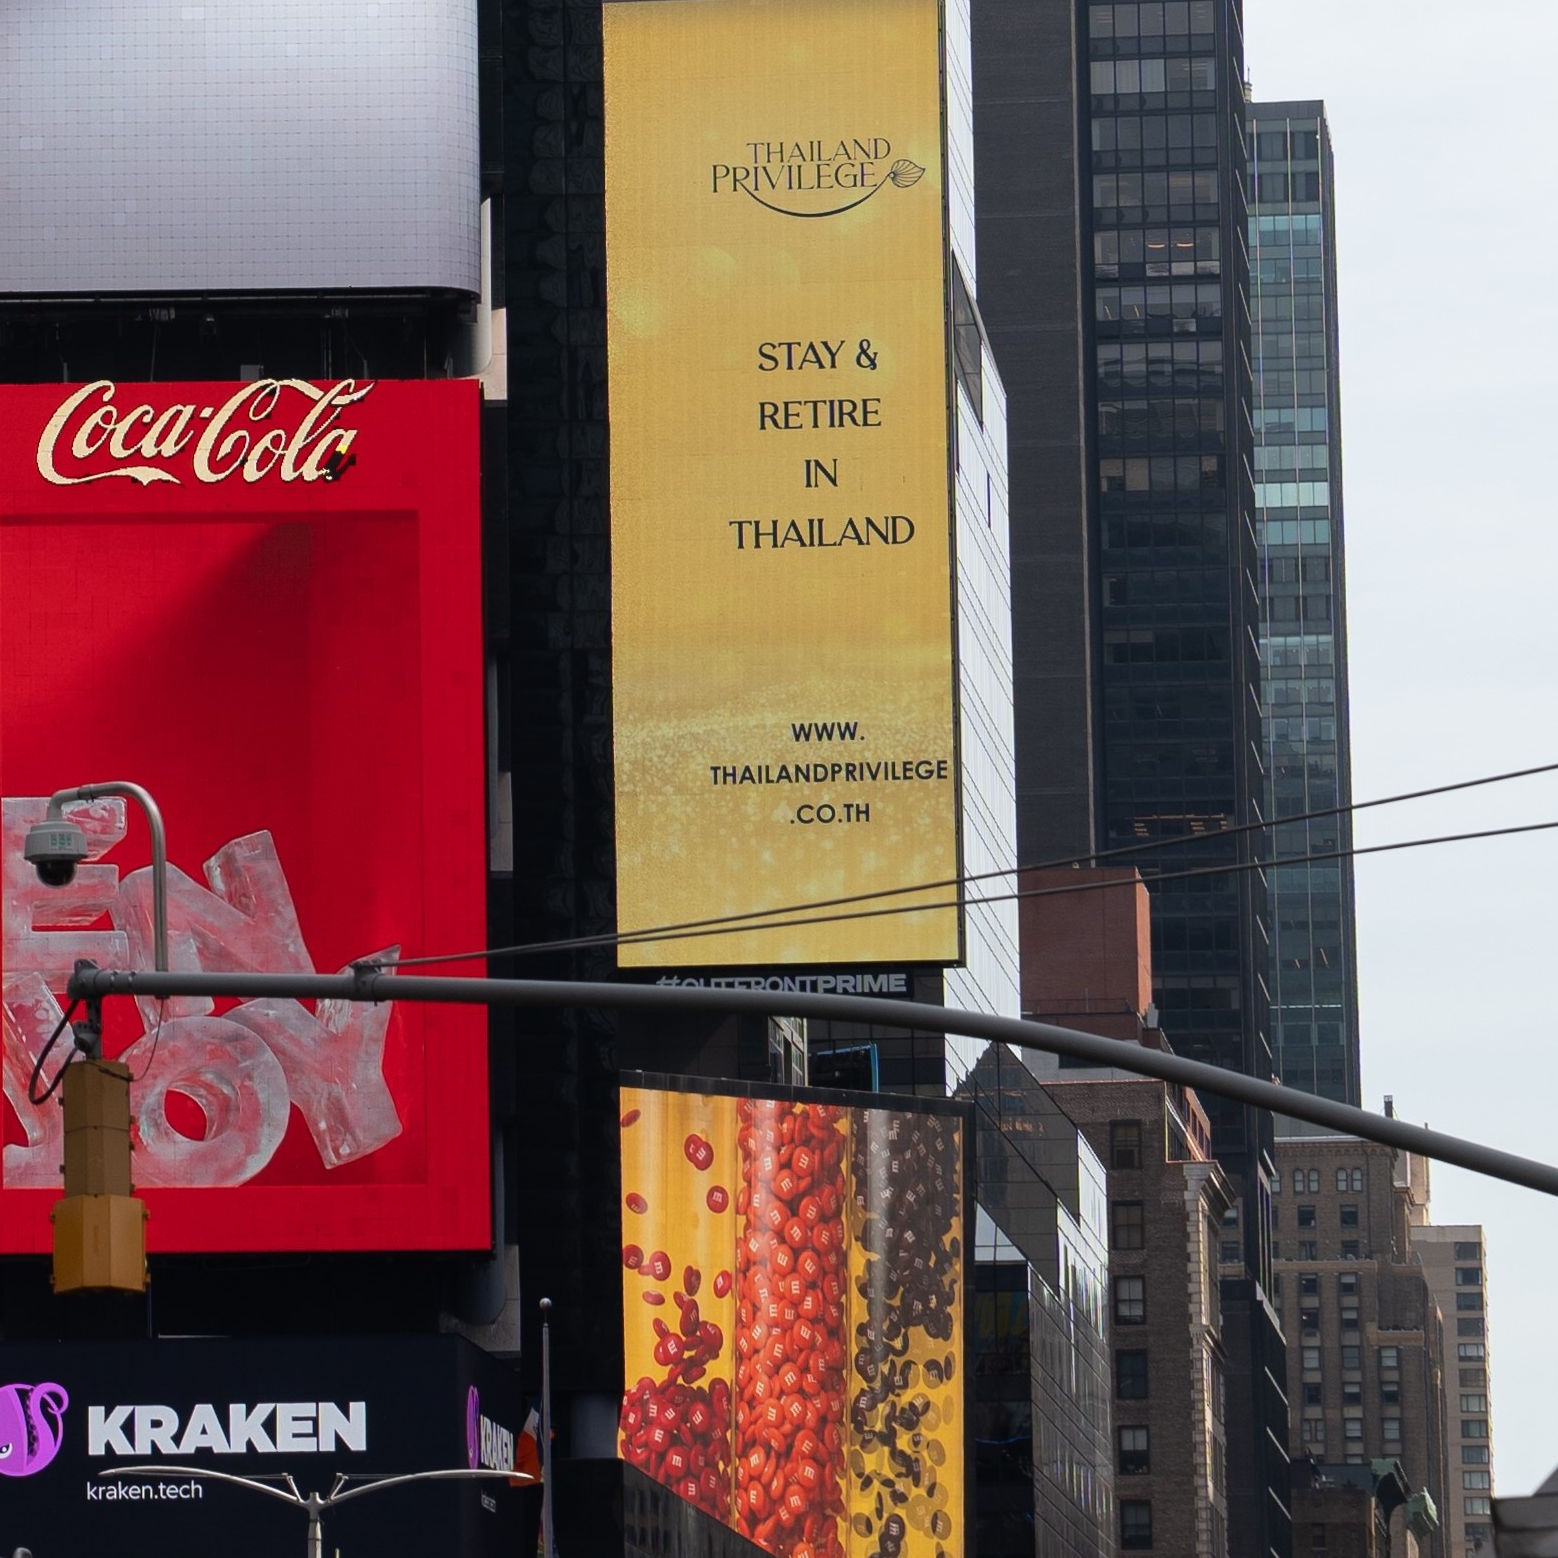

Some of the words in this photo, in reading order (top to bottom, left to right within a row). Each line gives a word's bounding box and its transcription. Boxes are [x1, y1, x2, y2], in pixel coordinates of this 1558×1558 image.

[746, 137, 892, 165] THAILAND
[712, 161, 880, 193] PRIVILEGE
[758, 340, 845, 372] STAY
[855, 338, 879, 371] &
[758, 398, 882, 430] RETIRE
[36, 379, 375, 486] Coca-Cola
[803, 458, 839, 489] IN
[729, 515, 916, 550] THAILAND
[791, 721, 866, 743] WWW.
[710, 759, 948, 786] THAILANDPRIVILEGE
[789, 803, 871, 825] .CO.TH
[87, 1400, 367, 1456] KRAKEN
[86, 1479, 203, 1500] kraken.tech
